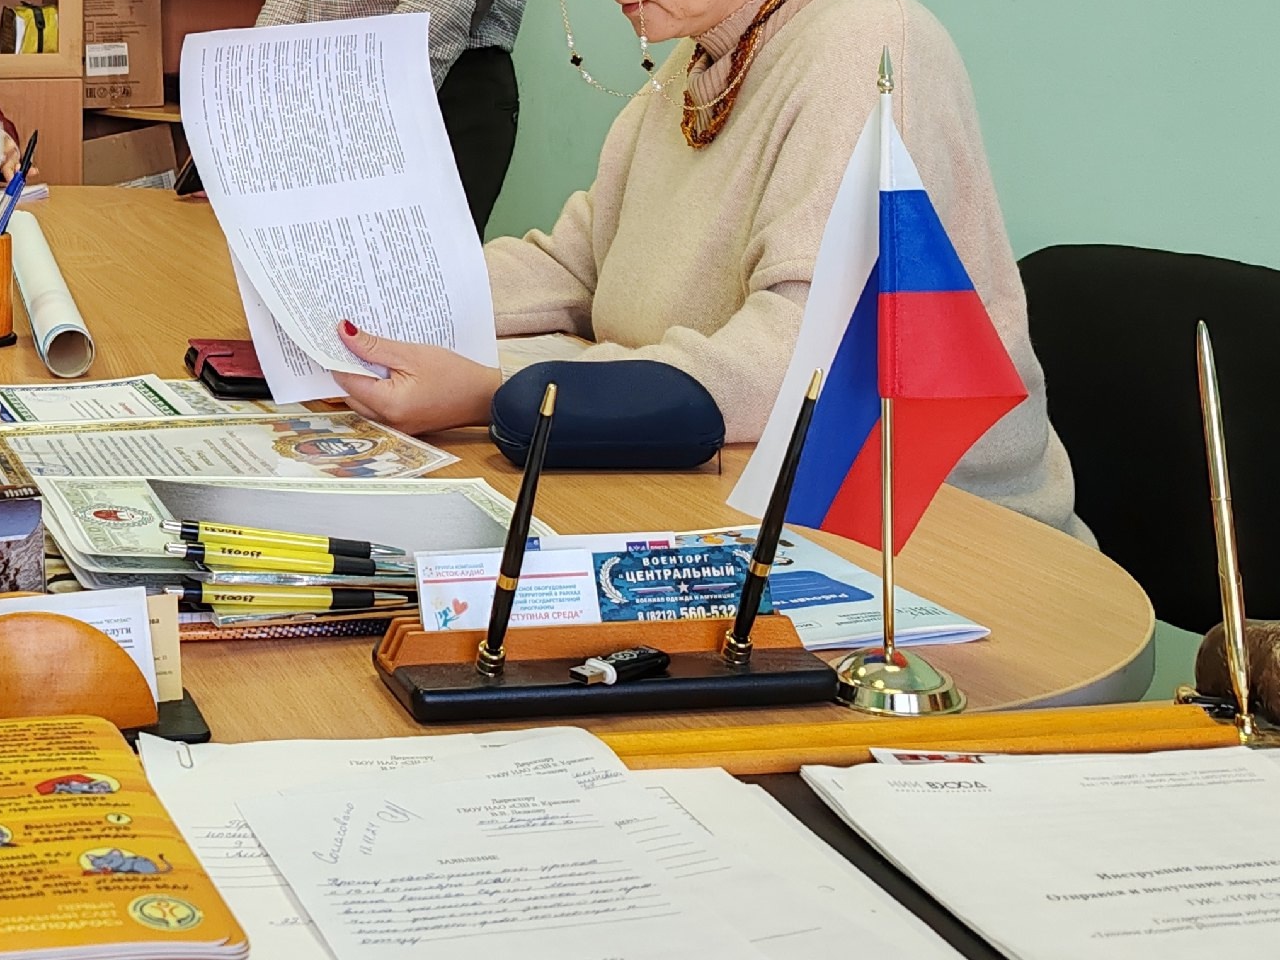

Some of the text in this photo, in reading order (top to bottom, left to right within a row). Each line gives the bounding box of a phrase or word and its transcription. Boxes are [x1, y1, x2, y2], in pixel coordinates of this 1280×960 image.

[642, 554, 710, 567] ВОЕНТОРГ
[435, 569, 485, 577] ИСТОК-АУДИО
[636, 596, 665, 604] ВОЕННАЯ
[666, 595, 693, 603] ОДЕЖДА
[791, 593, 849, 604] Рабочая
[509, 611, 550, 622] СТУПНАЯ
[680, 604, 737, 620] 560-532
[104, 627, 132, 637] слуги
[1096, 859, 1280, 881] Инструкция пользовате
[1046, 888, 1124, 901] Отправка
